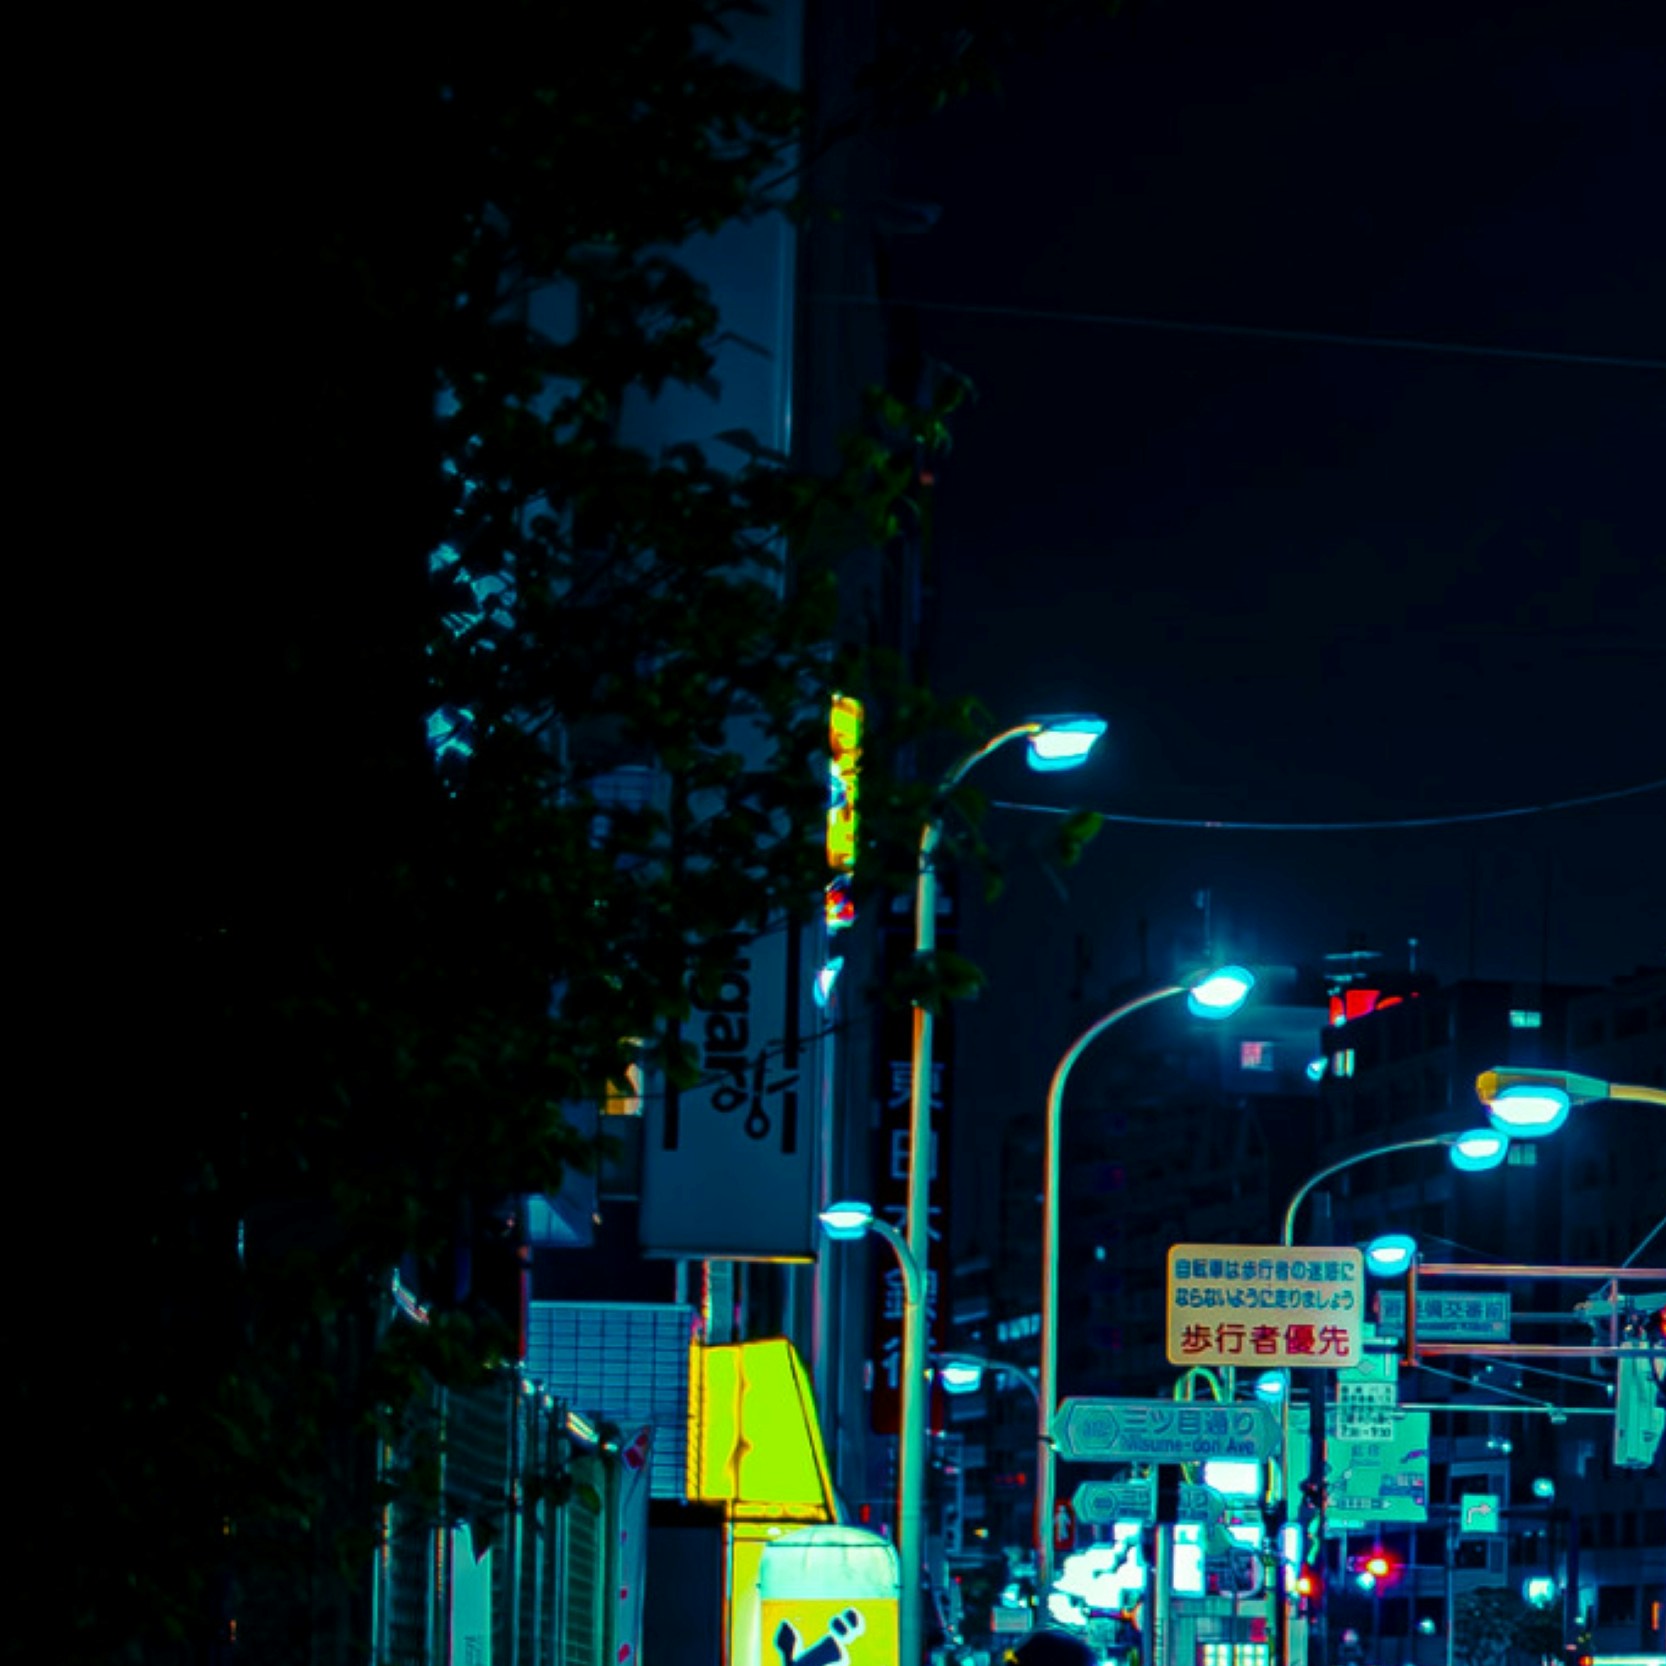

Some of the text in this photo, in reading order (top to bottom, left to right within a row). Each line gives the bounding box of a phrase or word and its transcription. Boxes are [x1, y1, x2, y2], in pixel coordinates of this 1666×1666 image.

[1180, 1321, 1350, 1357] 歩行者優先
[1123, 1408, 1255, 1436] 三ツ目通り
